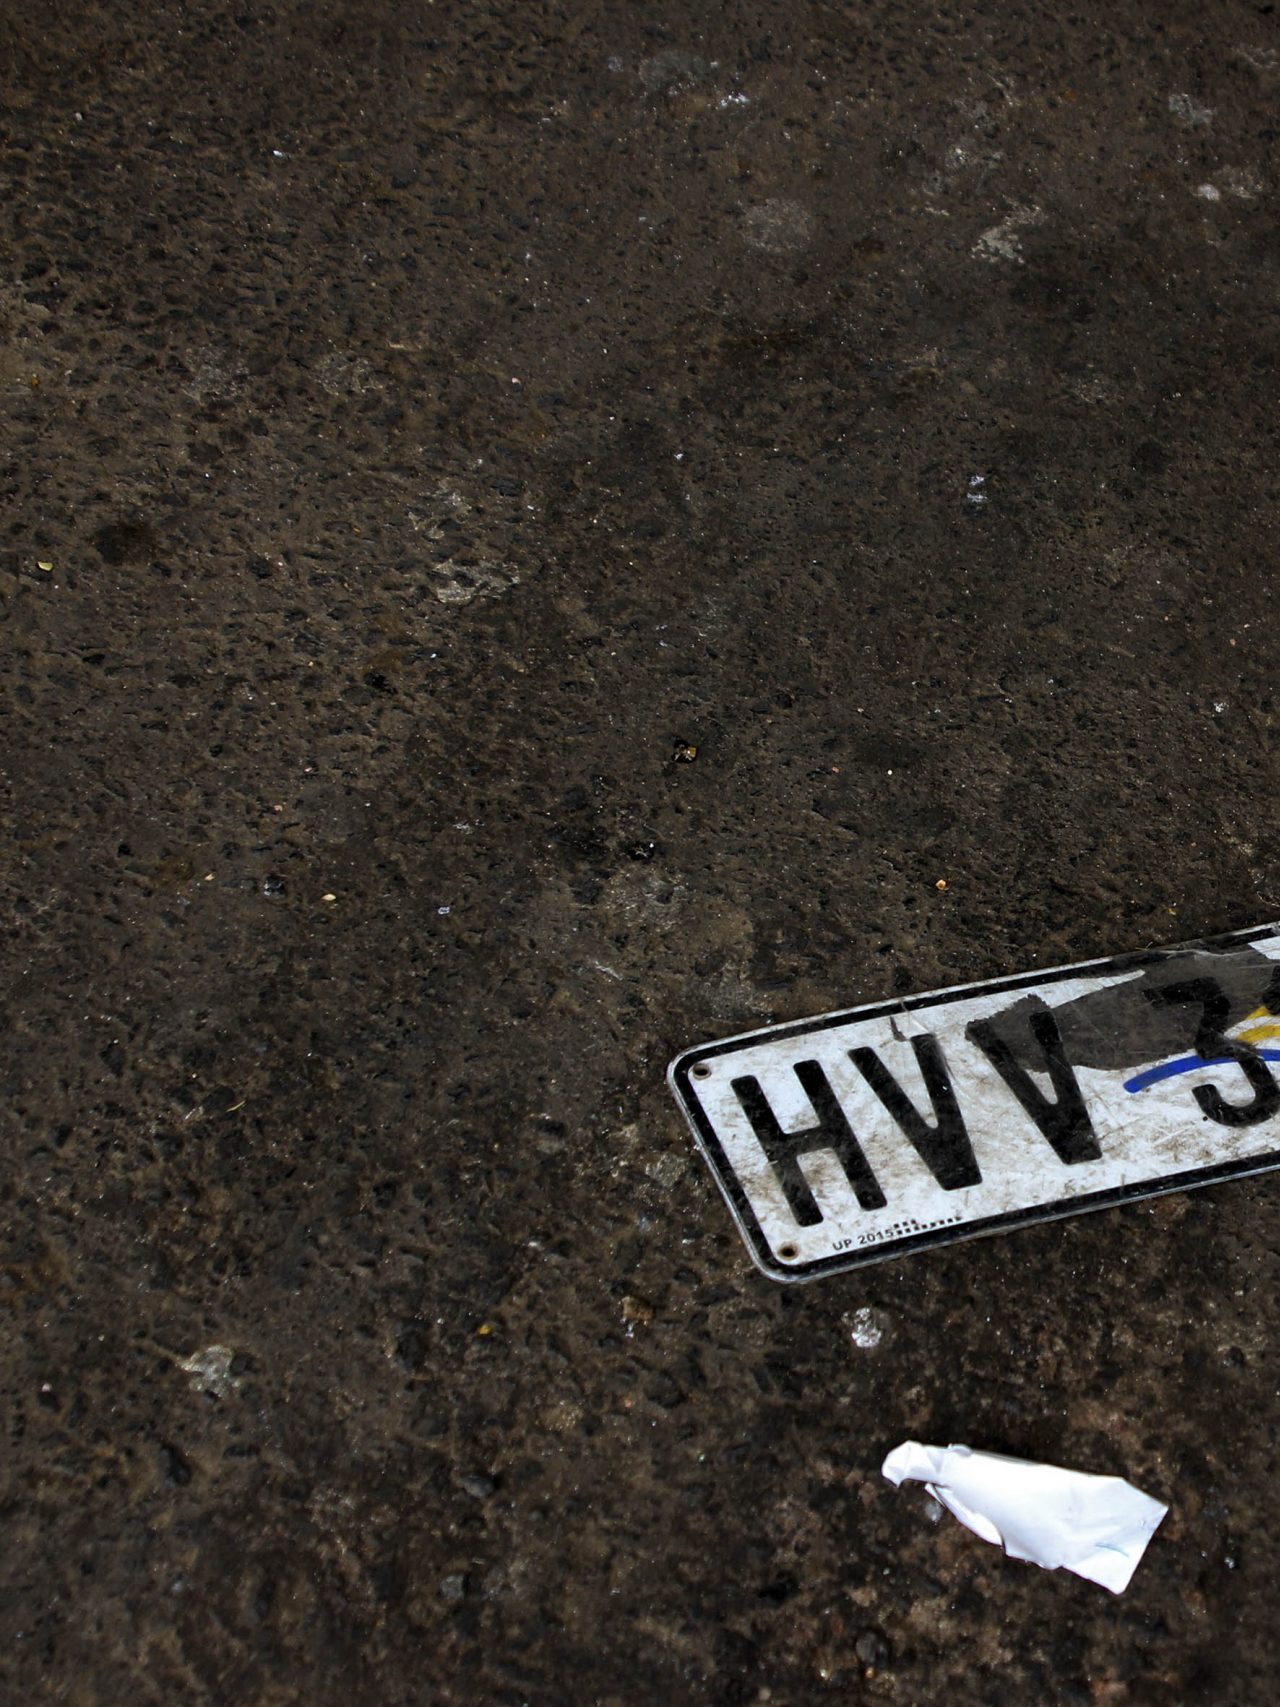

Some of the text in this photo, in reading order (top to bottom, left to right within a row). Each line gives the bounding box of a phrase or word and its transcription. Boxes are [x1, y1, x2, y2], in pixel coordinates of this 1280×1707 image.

[731, 1010, 1102, 1226] HVV
[832, 1228, 895, 1251] UP 2015
